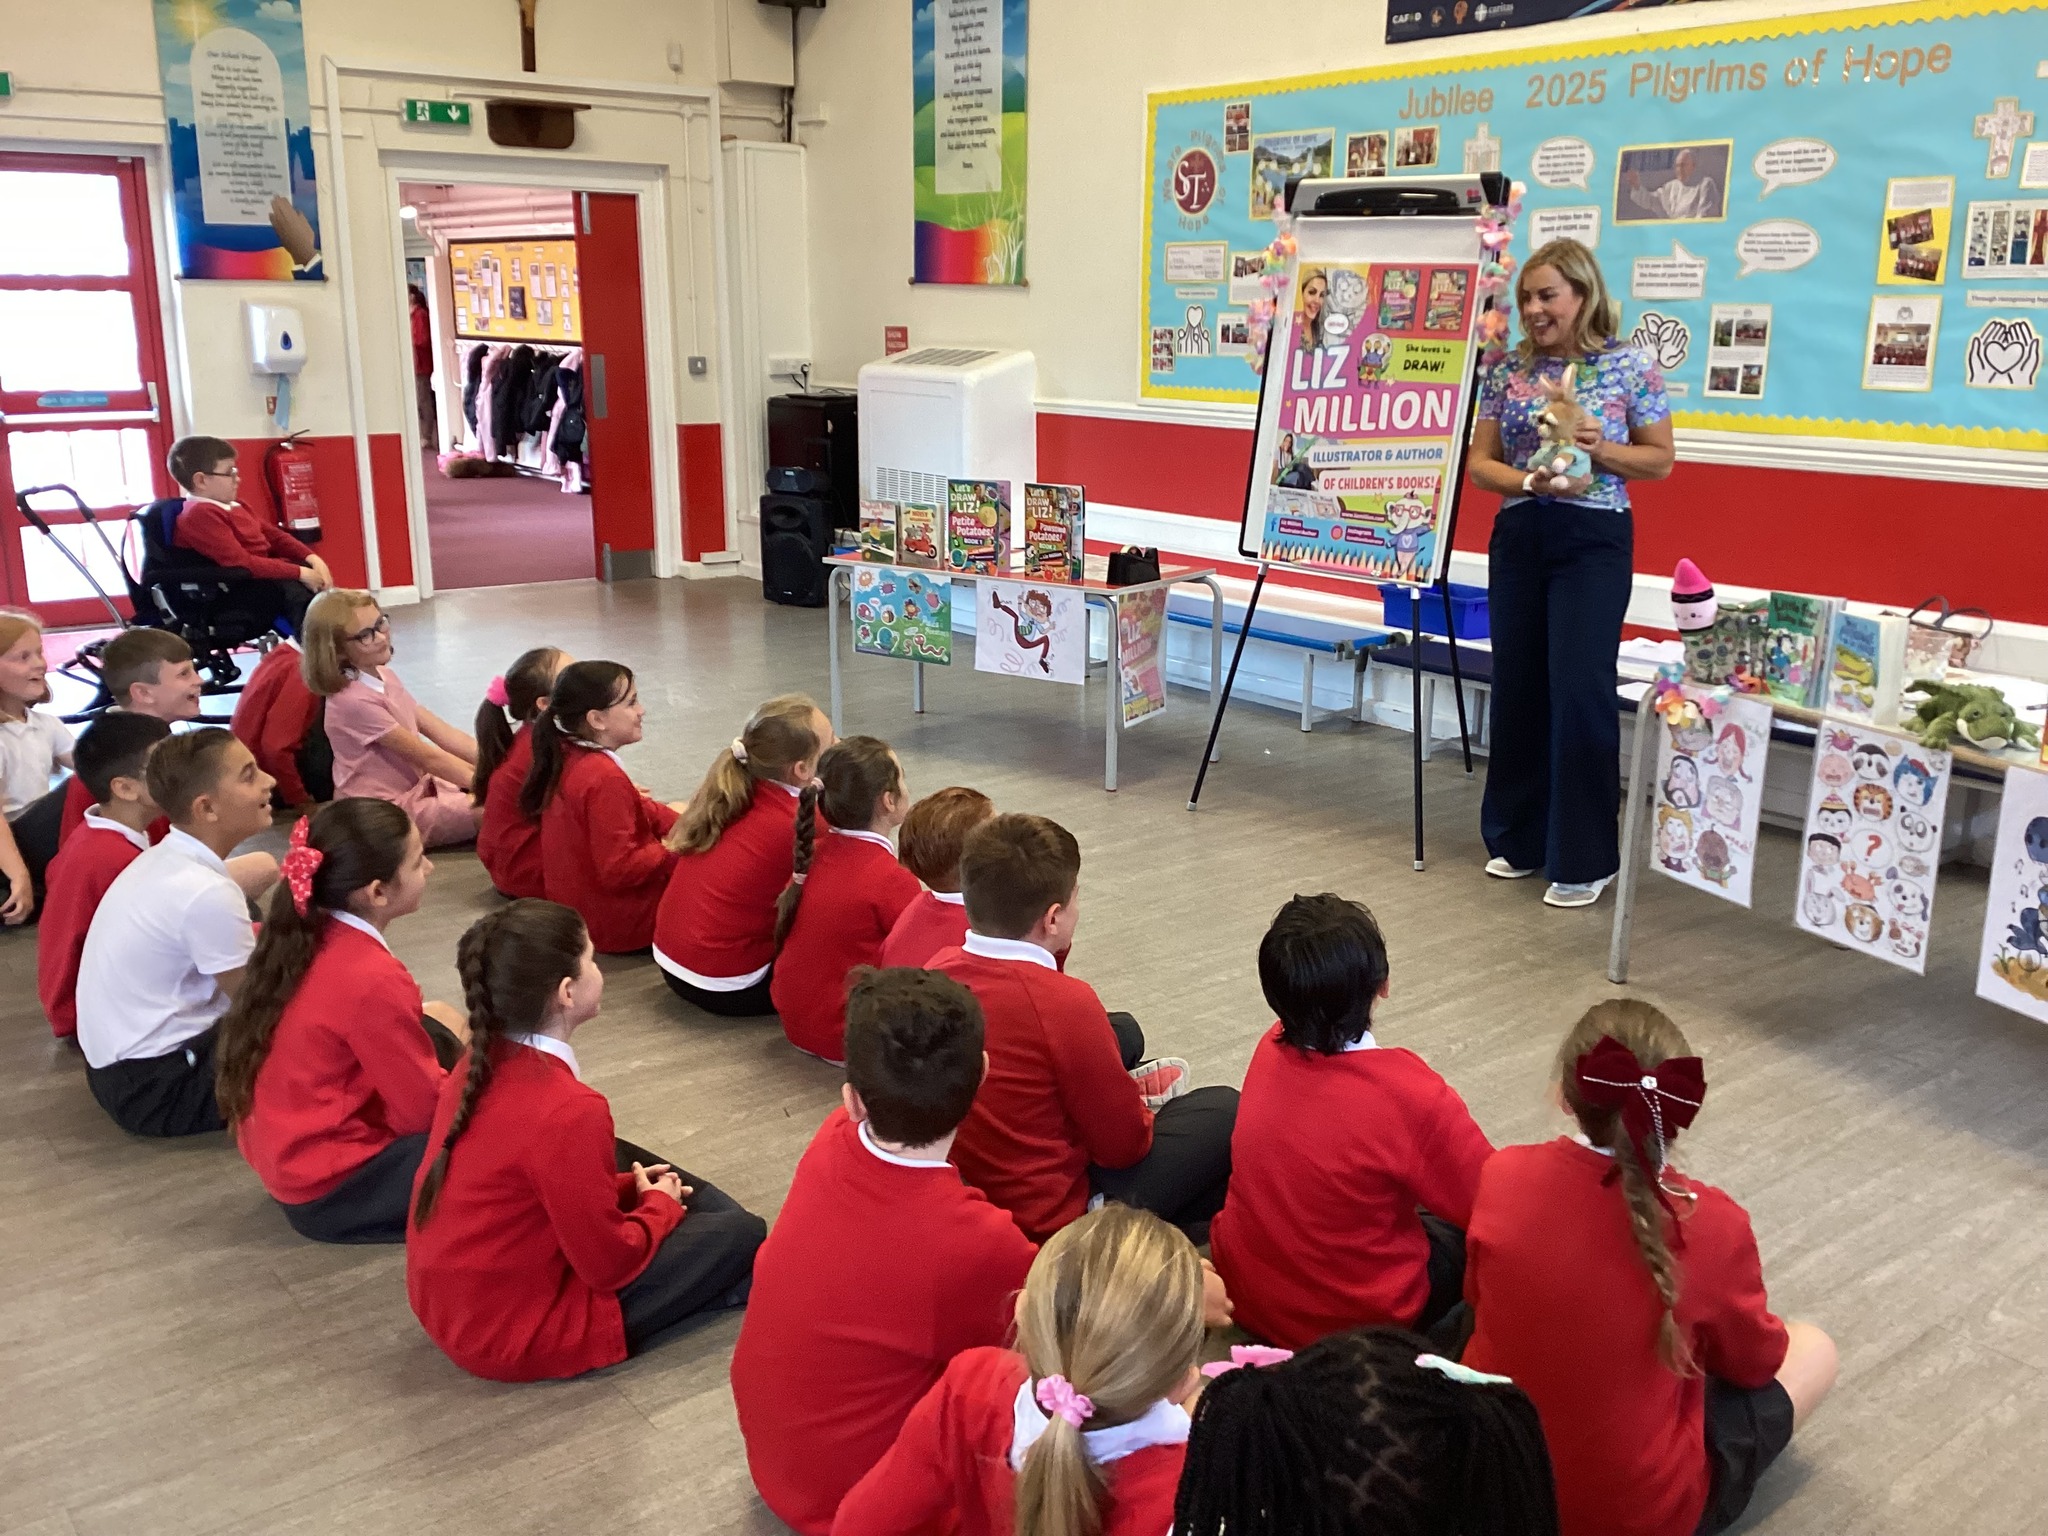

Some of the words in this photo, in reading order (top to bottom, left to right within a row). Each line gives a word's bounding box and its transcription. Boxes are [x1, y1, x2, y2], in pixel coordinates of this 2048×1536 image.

[1526, 69, 1607, 109] 2025
[1784, 48, 1828, 87] of
[1841, 42, 1952, 88] Hope
[1405, 343, 1419, 352] She
[1421, 344, 1441, 353] loves
[1443, 345, 1452, 354] to
[1291, 344, 1350, 391] LIZ
[1403, 359, 1446, 374] DRAW!
[1293, 389, 1452, 434] MILLION
[1313, 449, 1383, 463] ILLUSTRATOR
[1385, 449, 1393, 461] &
[1395, 448, 1443, 460] AUTHOR
[1323, 478, 1336, 490] OF
[1338, 477, 1394, 490] CHILDREN'S
[1396, 476, 1435, 489] BOOKS!
[950, 493, 977, 502] DRAW
[1027, 497, 1050, 507] DRAW
[956, 500, 980, 514] LIZ!
[1032, 505, 1053, 518] LIZ!
[952, 515, 976, 526] Petite
[956, 526, 994, 537] Potatoes!
[1028, 530, 1063, 542] Potatoes!
[963, 537, 978, 545] BOOK
[1128, 620, 1142, 644] LIZ
